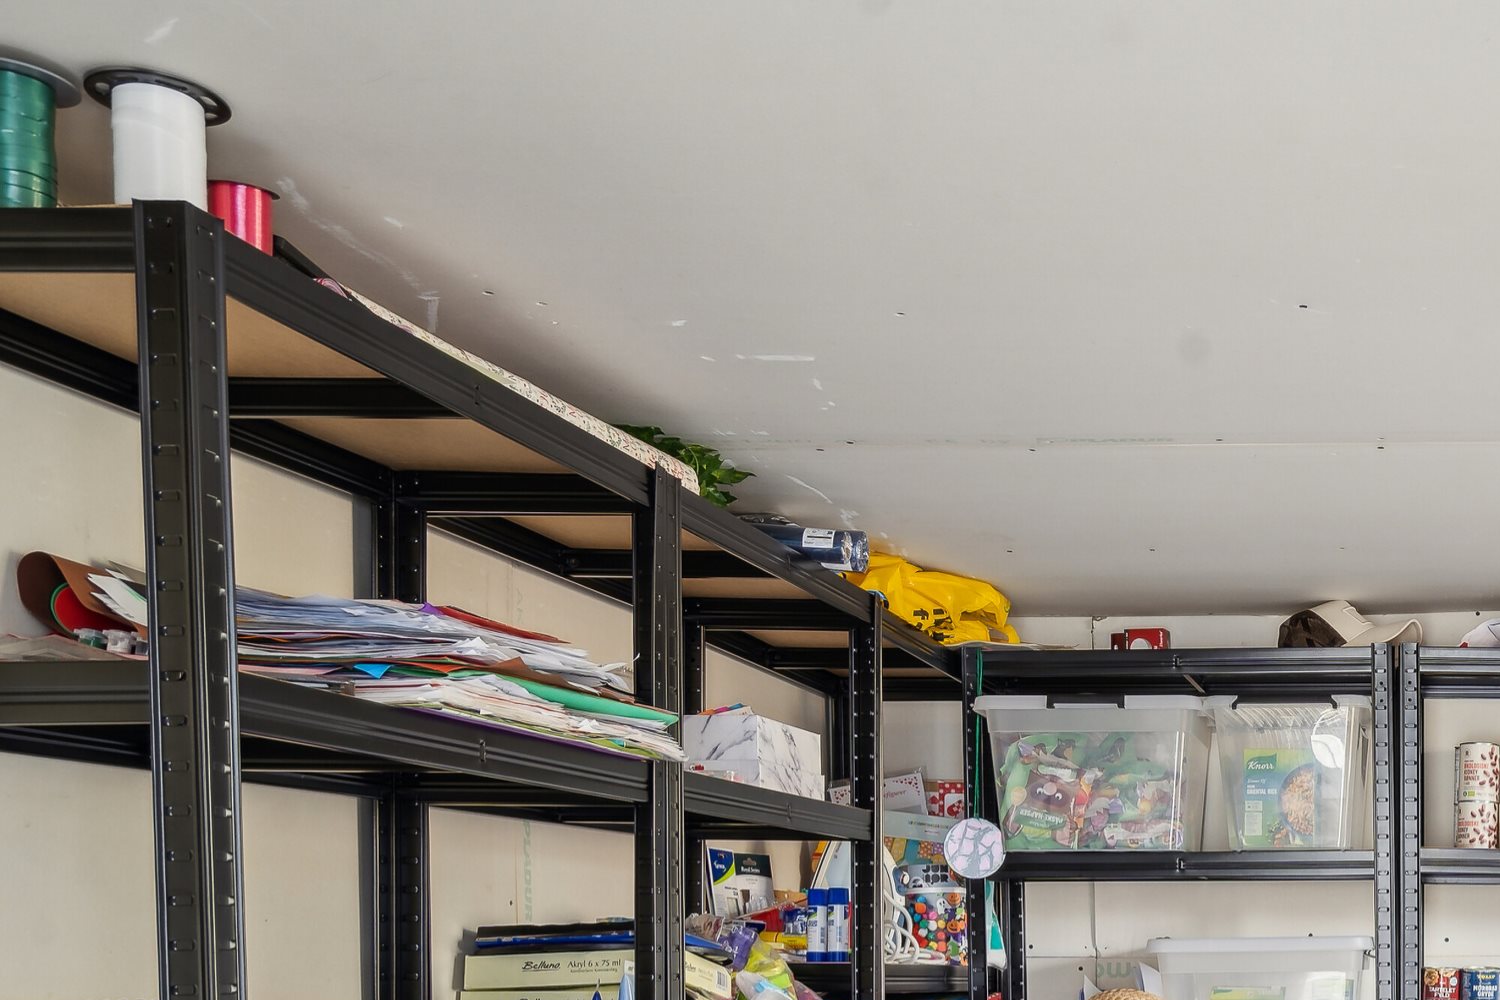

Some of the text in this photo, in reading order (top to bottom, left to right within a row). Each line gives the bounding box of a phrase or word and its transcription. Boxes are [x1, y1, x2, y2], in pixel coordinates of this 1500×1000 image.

[1247, 761, 1274, 770] Knorr
[521, 960, 561, 971] Belluno
[567, 959, 586, 969] Akryl
[601, 959, 611, 967] 75
[611, 958, 621, 966] ml
